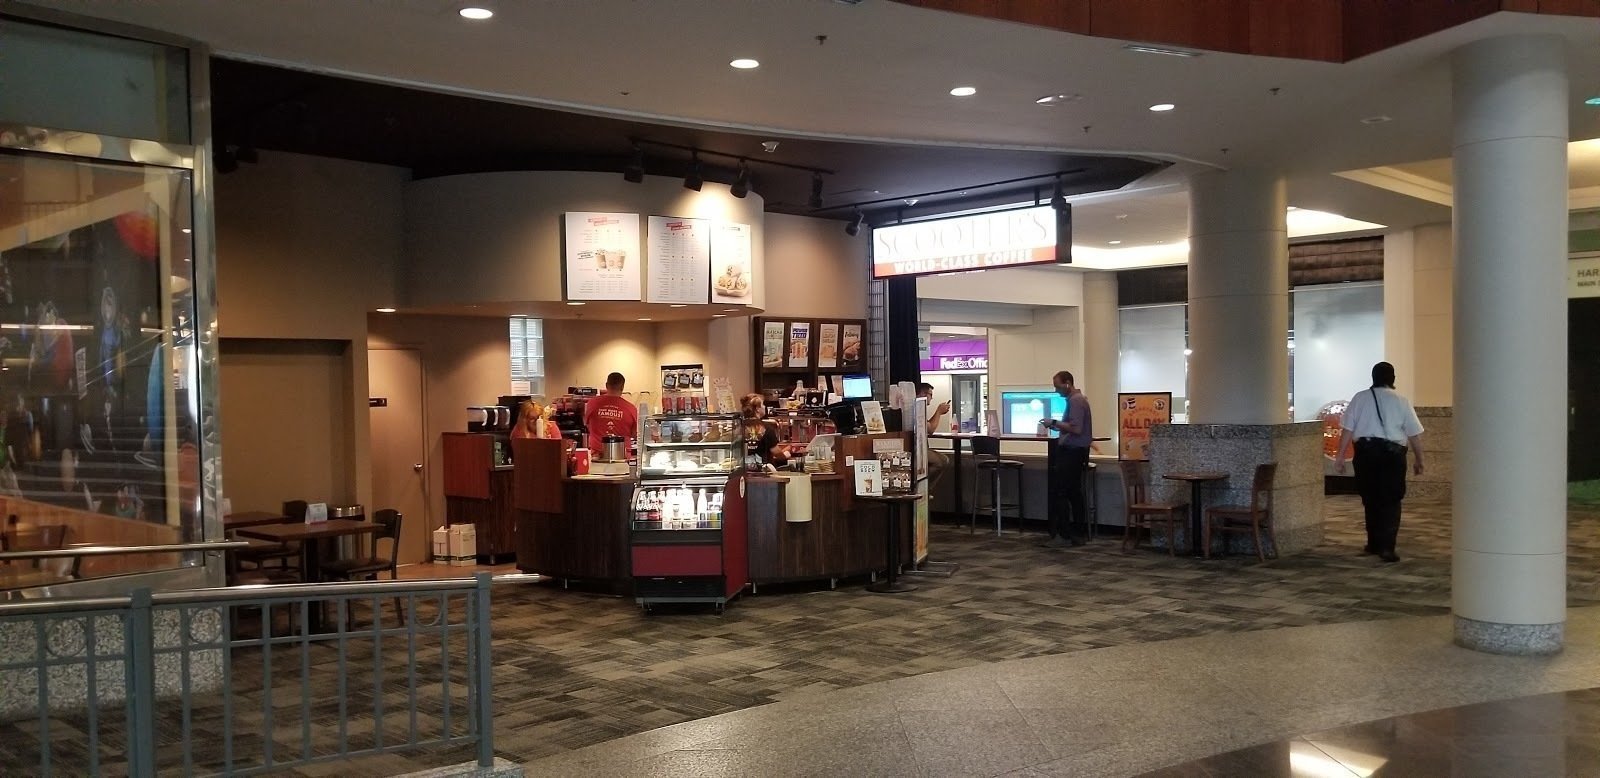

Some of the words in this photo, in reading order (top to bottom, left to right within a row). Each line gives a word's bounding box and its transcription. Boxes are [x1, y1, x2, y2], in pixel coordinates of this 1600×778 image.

[879, 213, 1047, 255] SCOOTER'S
[894, 254, 981, 274] WORLD-CLASS
[982, 248, 1033, 267] COFFEE
[940, 357, 969, 370] FedEx
[1122, 417, 1143, 429] ALL
